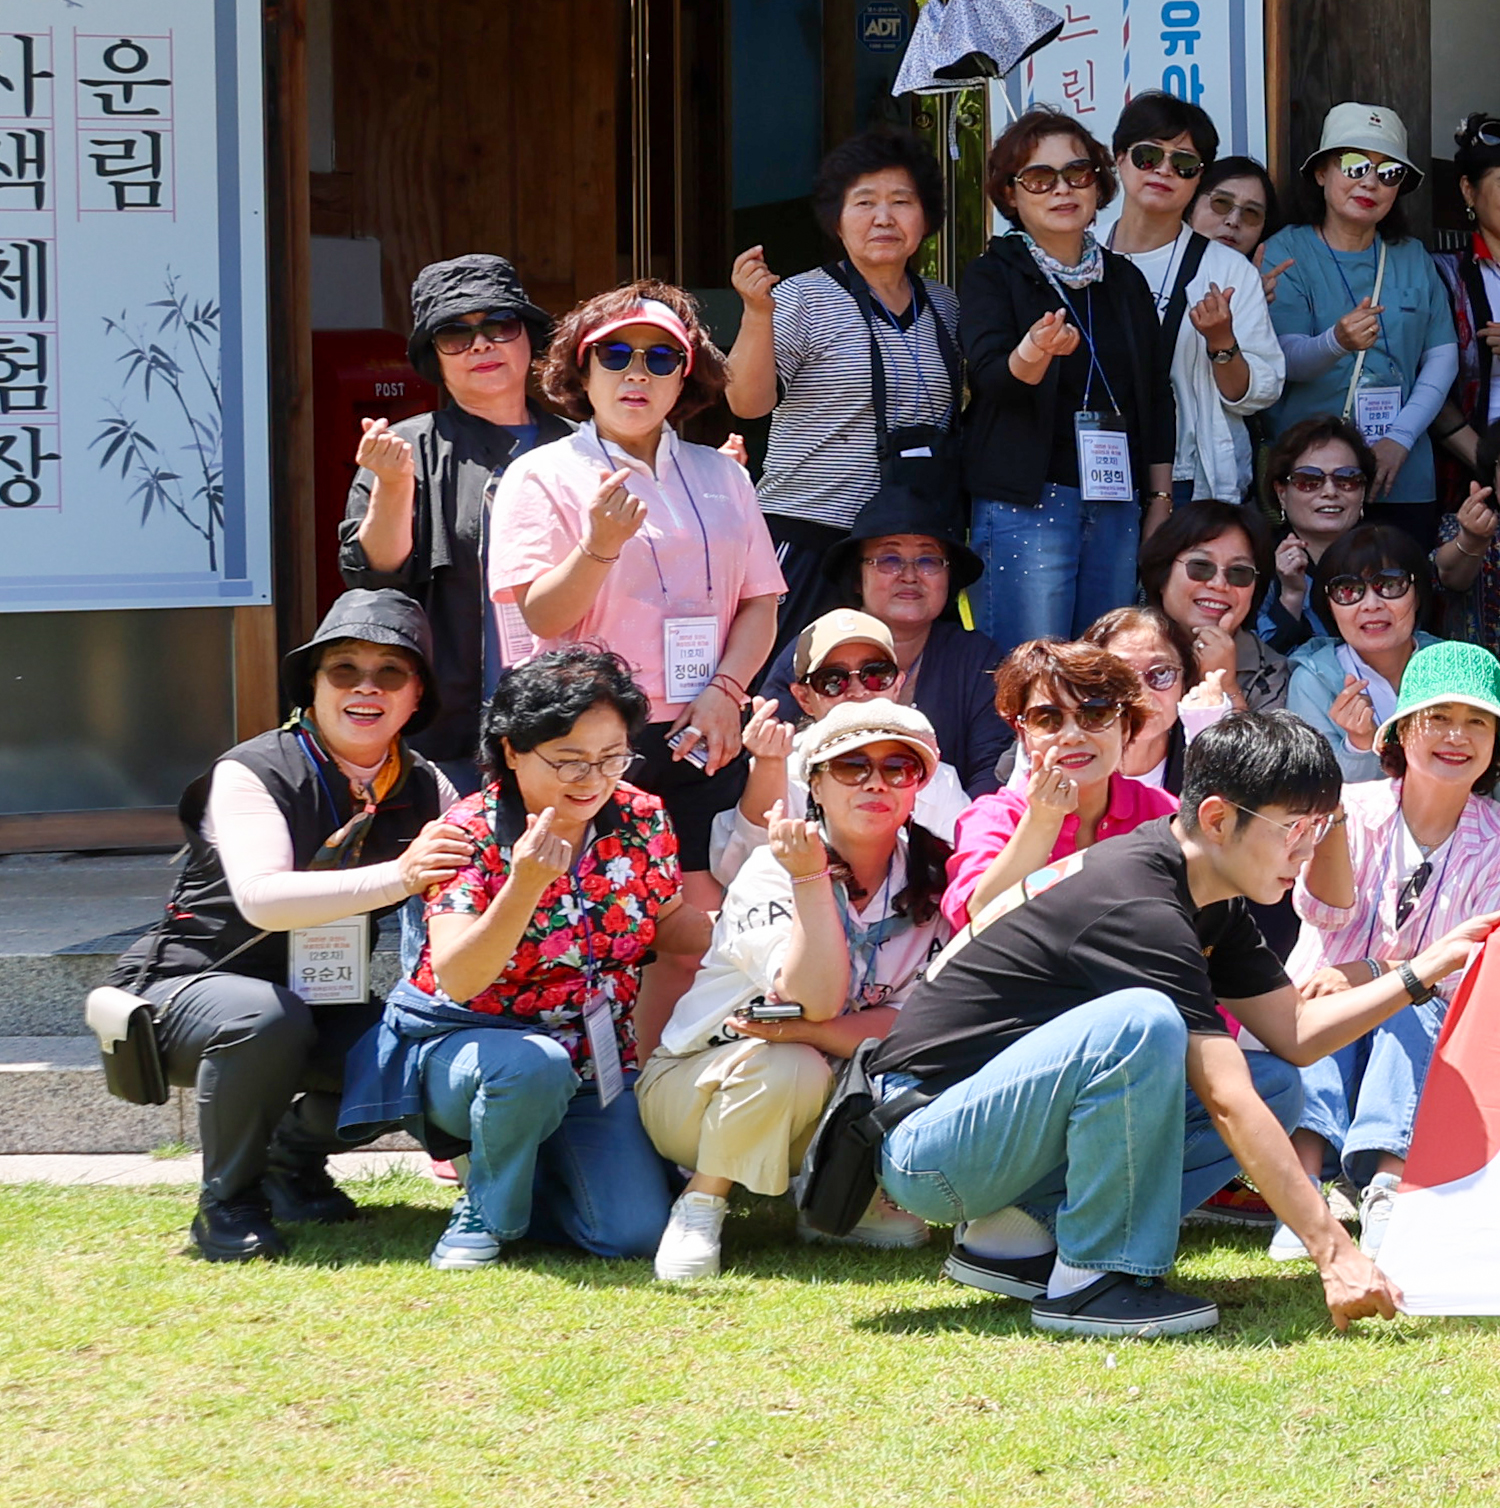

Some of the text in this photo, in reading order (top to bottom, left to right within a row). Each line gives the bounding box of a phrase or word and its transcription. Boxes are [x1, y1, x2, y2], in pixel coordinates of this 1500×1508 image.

[865, 18, 901, 36] ADT
[78, 38, 173, 213] 운림
[375, 382, 405, 397] POST
[1091, 469, 1125, 485] 이정희
[675, 663, 711, 680] 정언이
[301, 965, 354, 983] 유순자
